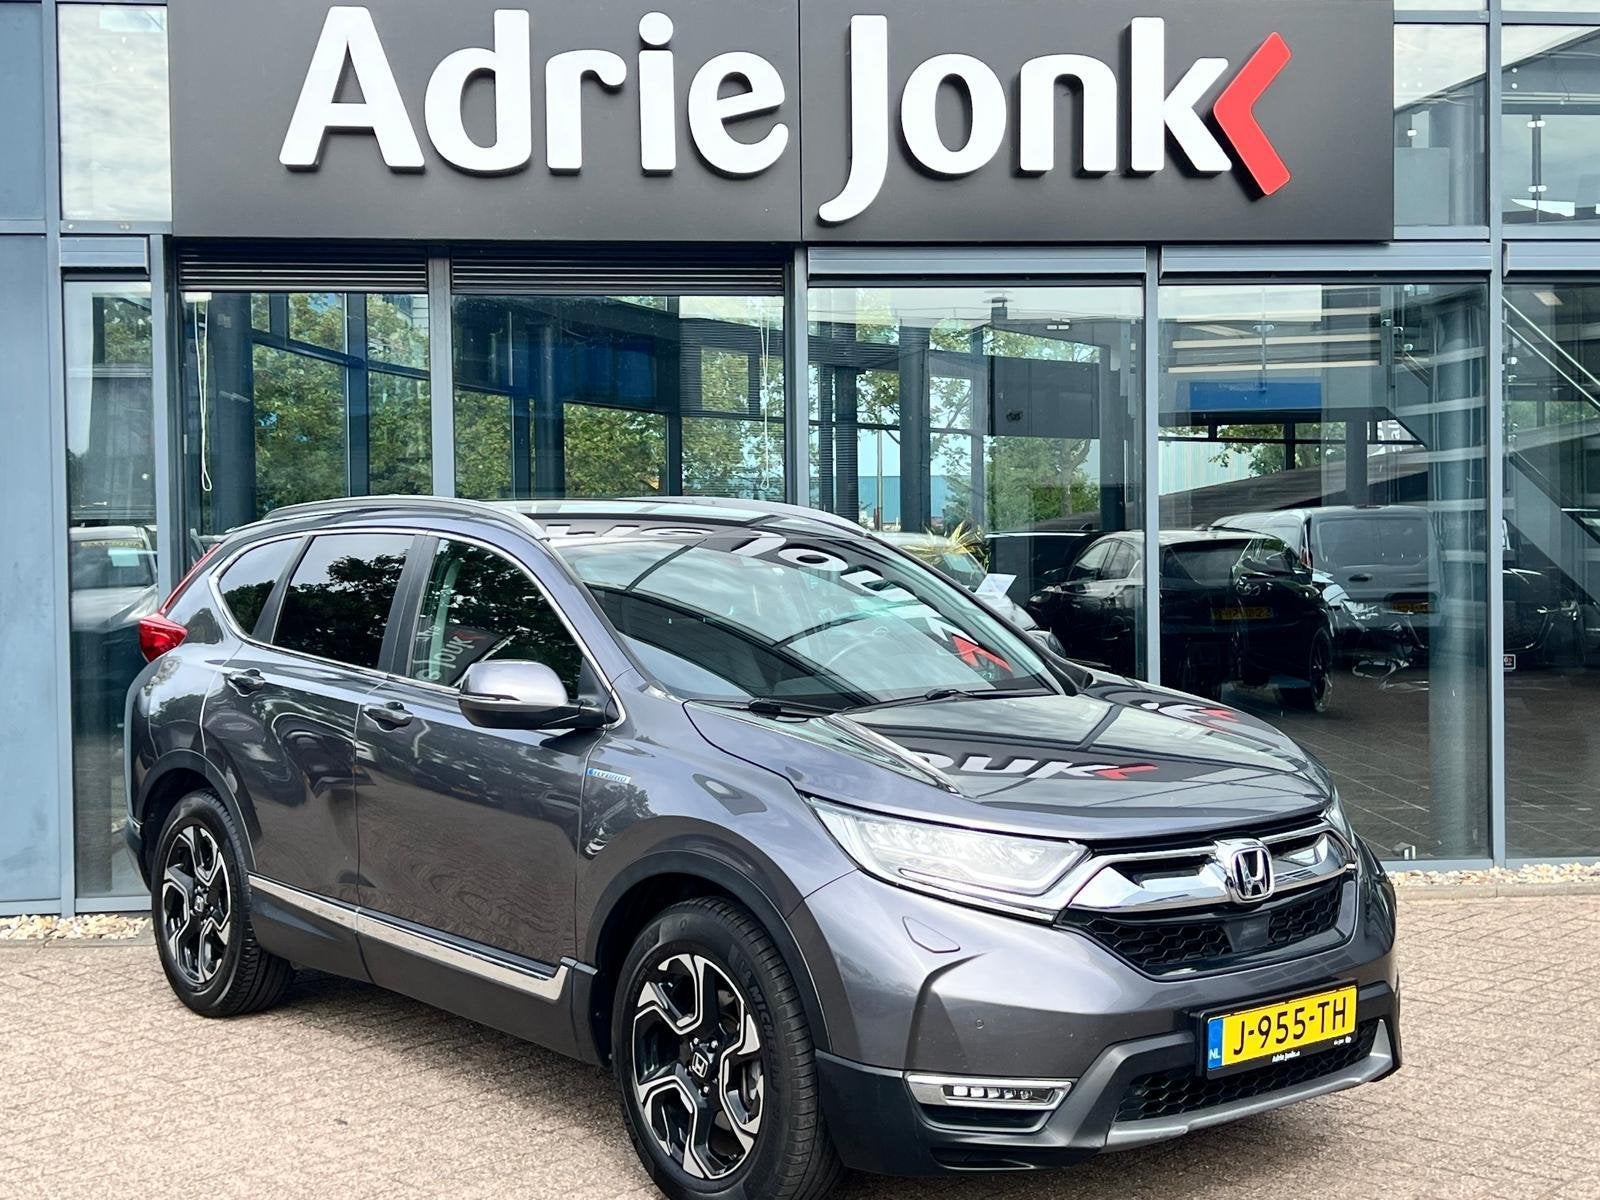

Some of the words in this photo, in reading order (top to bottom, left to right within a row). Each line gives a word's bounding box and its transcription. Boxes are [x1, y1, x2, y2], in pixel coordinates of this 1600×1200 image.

[279, 6, 789, 174] Adrie
[818, 15, 1233, 222] Jonk
[1208, 1047, 1221, 1061] NL
[1233, 997, 1347, 1055] J-955-TH
